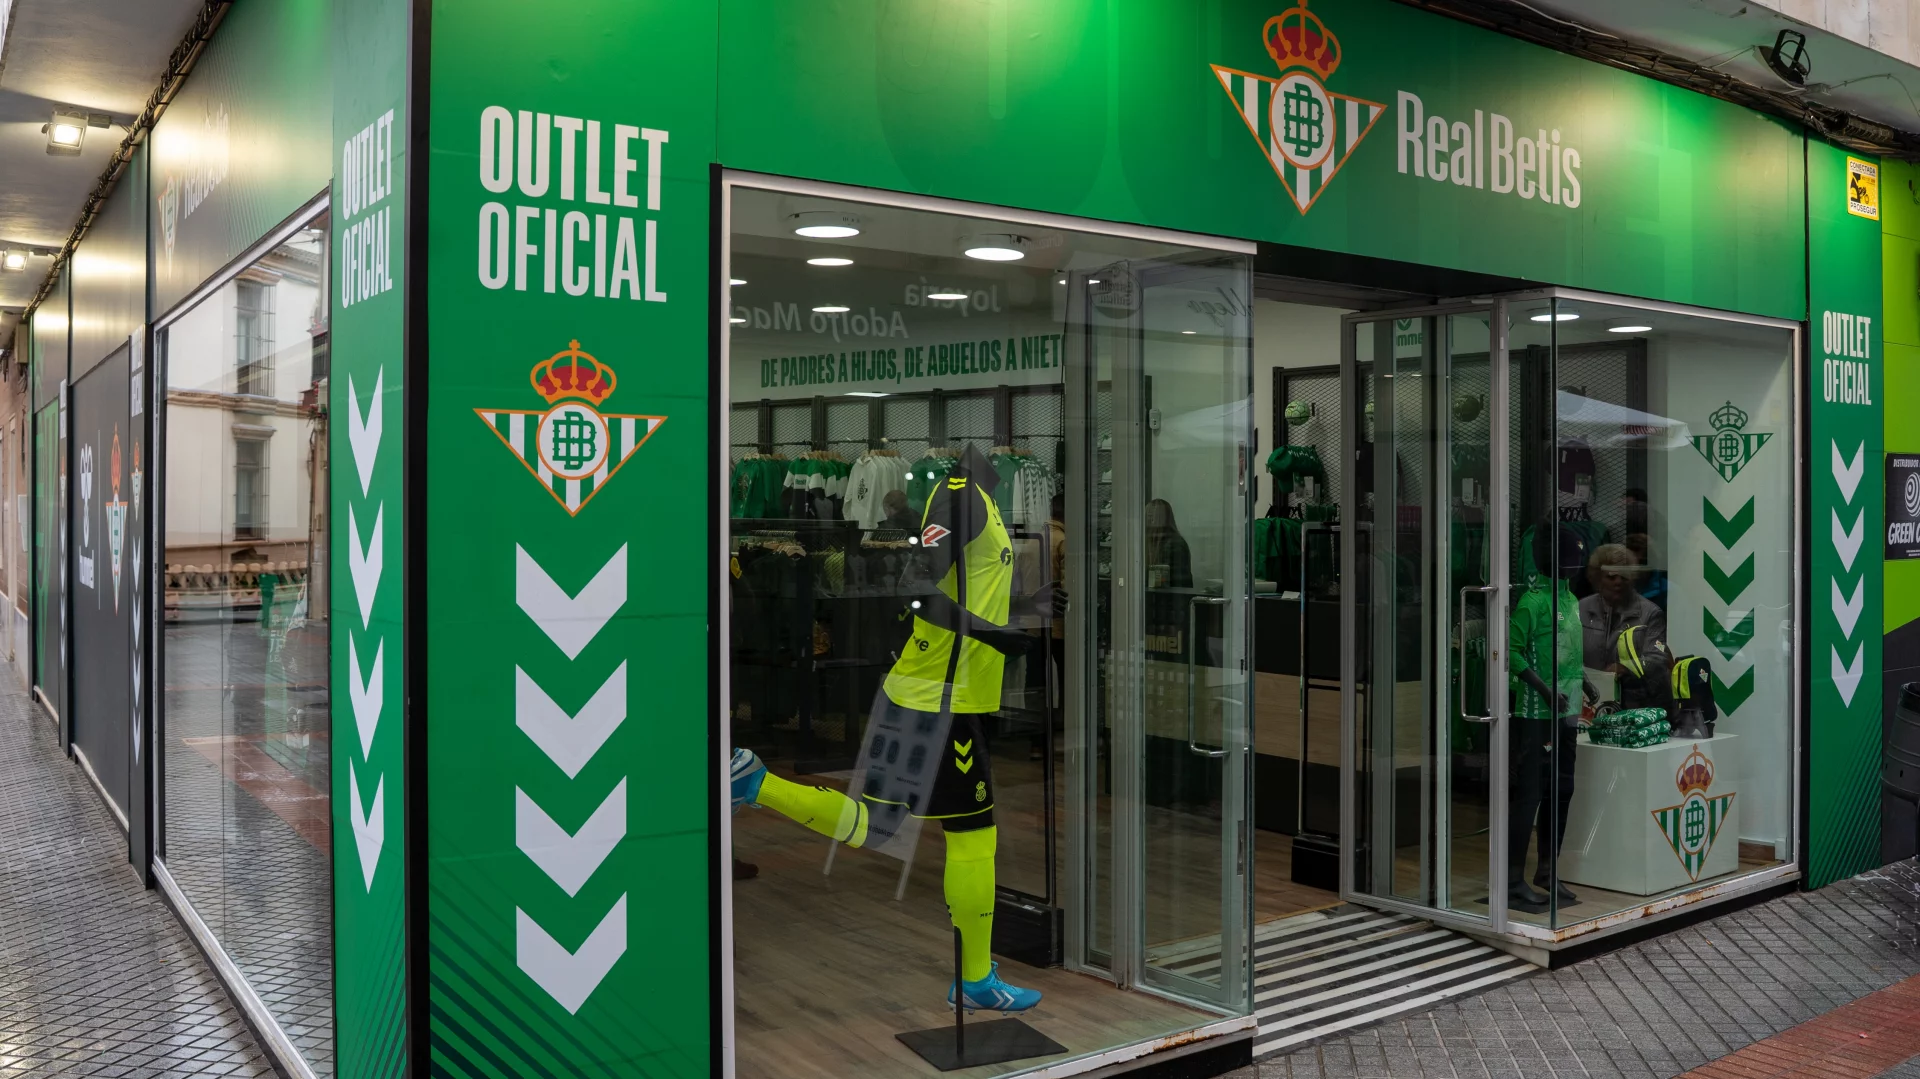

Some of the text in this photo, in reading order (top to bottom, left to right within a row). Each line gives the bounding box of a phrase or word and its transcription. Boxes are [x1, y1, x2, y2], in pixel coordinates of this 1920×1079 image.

[343, 108, 394, 221] OUTLET
[479, 105, 669, 211] OUTLET
[1850, 202, 1877, 216] PROSEGUR
[342, 205, 393, 309] OFICIAL
[478, 201, 667, 303] OFICIAL
[760, 333, 1065, 388] DE PADRES A HIJOS, DE ABUELOS A NIET
[1823, 310, 1871, 359] OUTLET
[1823, 358, 1872, 406] OFICIAL
[1887, 522, 1916, 546] GREEN
